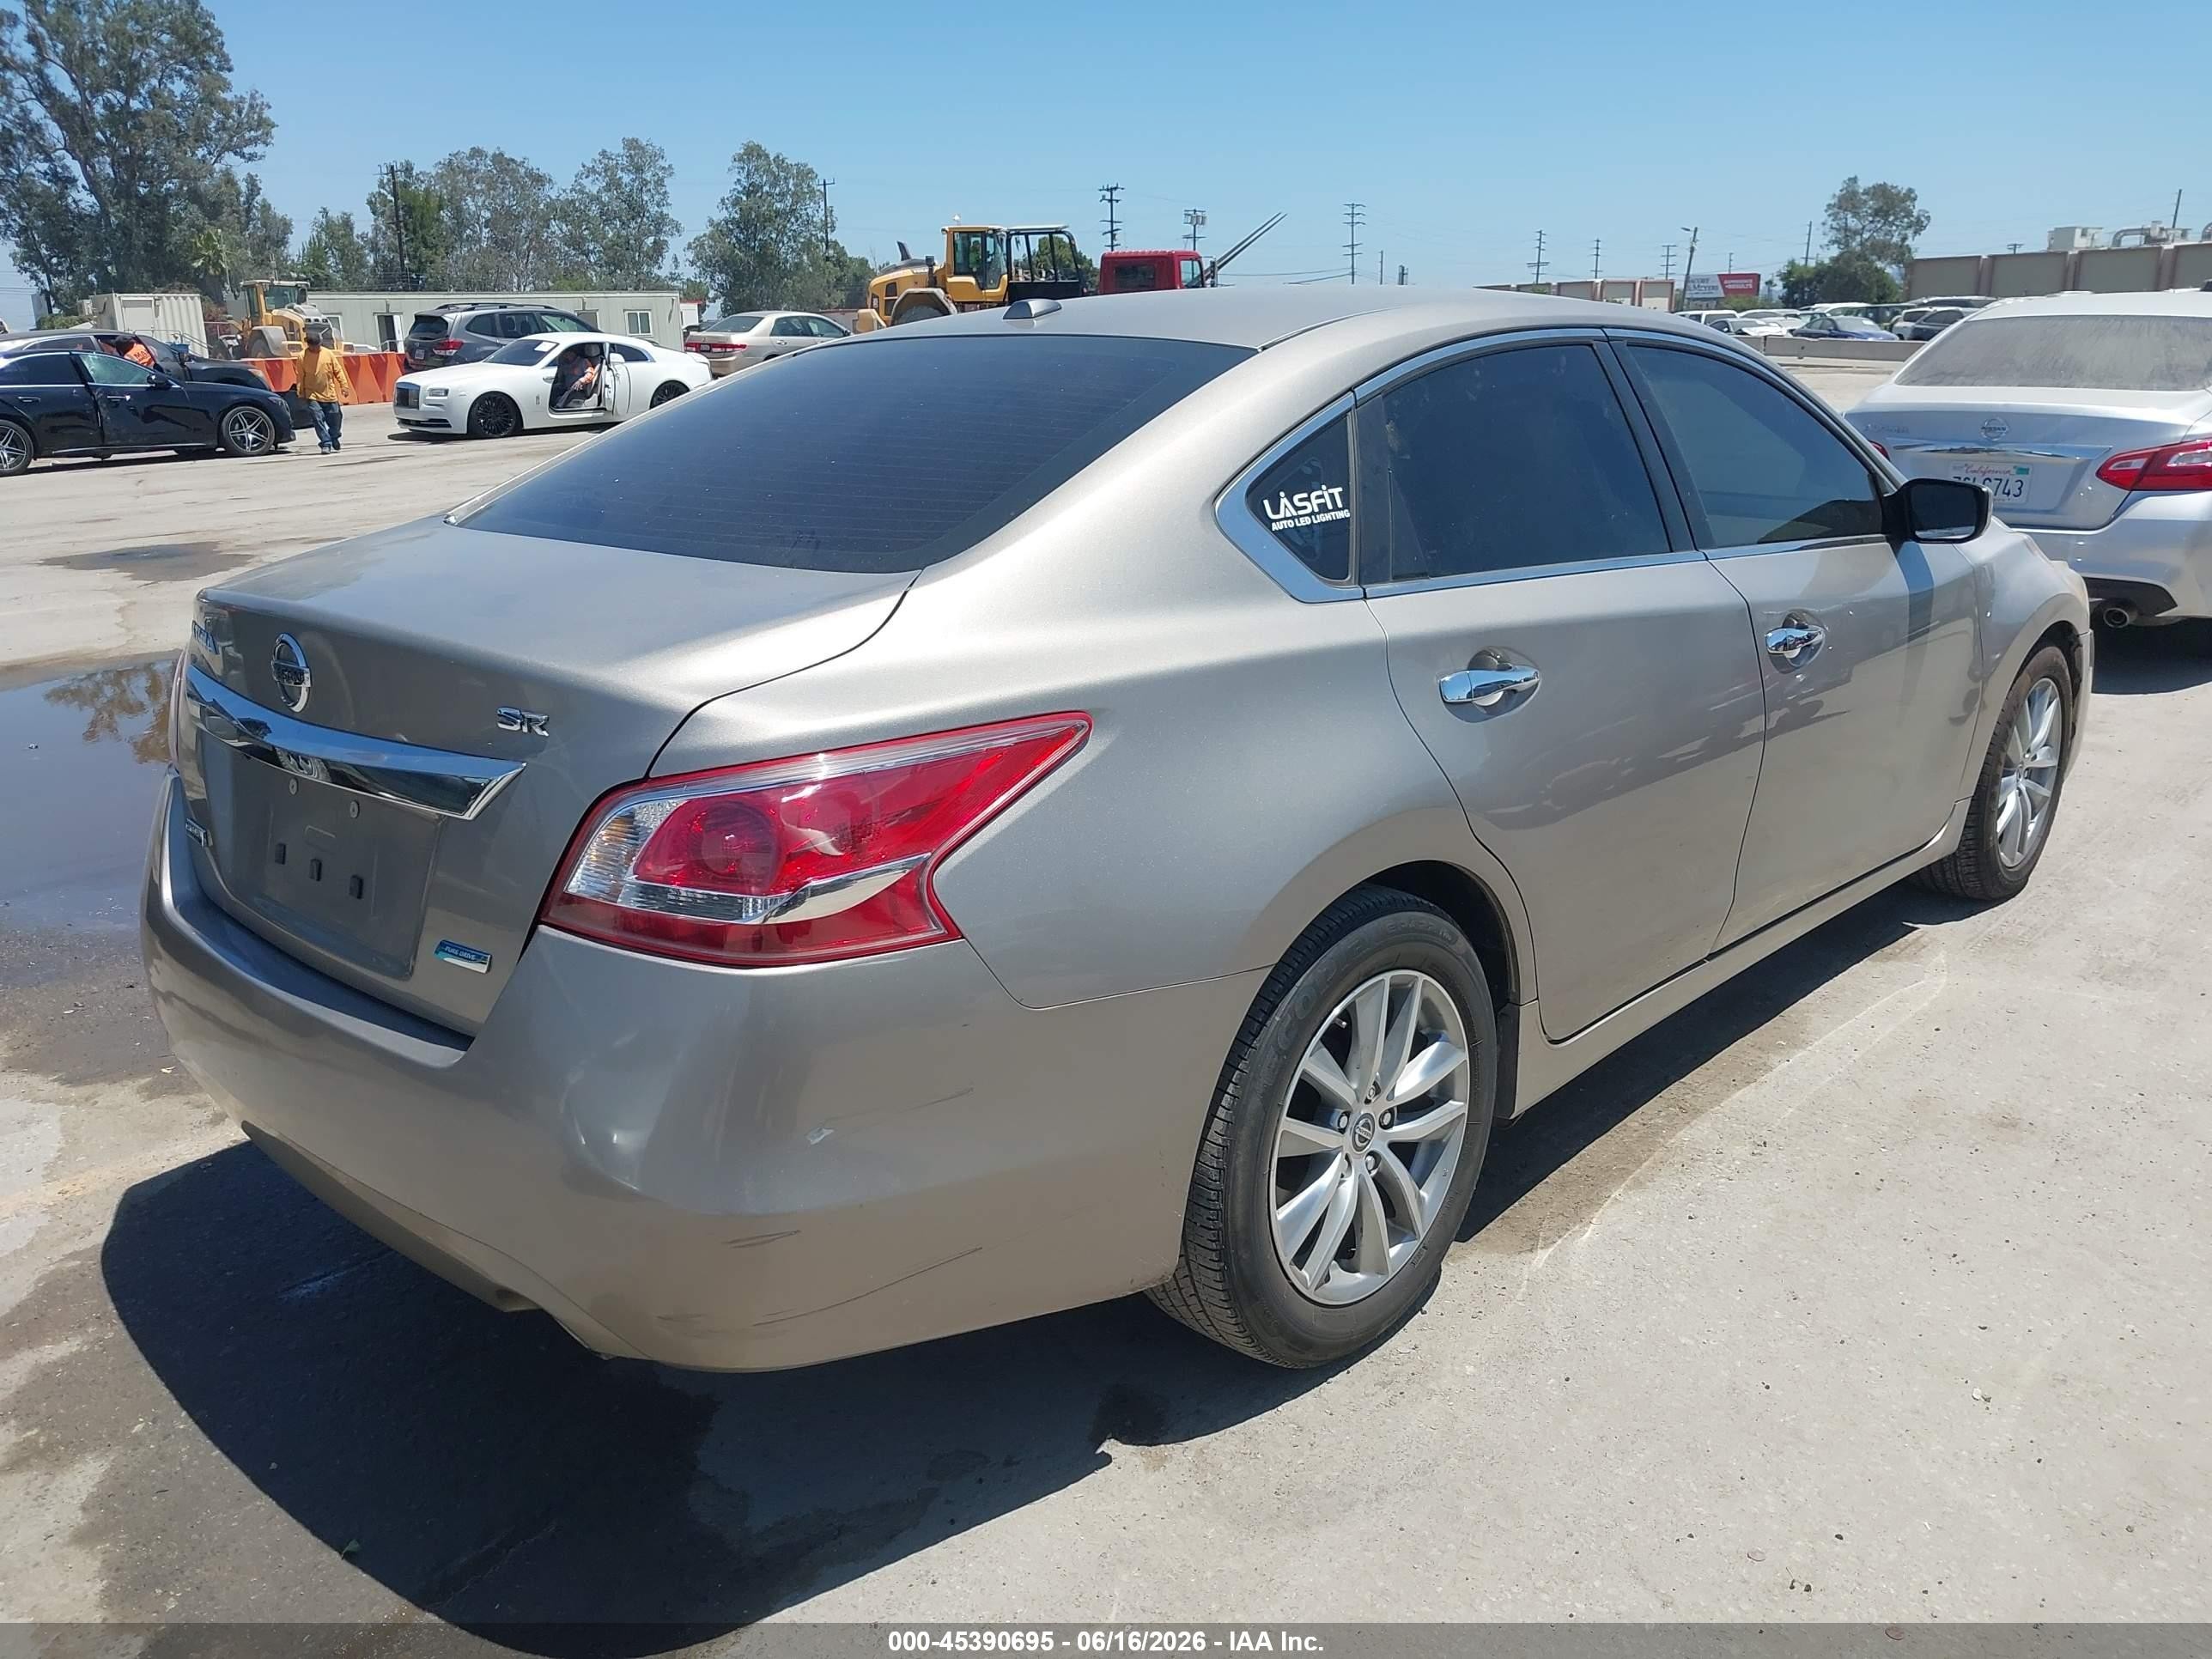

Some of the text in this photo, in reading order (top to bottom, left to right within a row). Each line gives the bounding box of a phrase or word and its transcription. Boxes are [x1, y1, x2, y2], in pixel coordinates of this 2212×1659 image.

[1965, 465, 2013, 477] California
[1271, 509, 1350, 532] AUTO LED LIGHTING
[496, 706, 550, 737] SR
[444, 945, 477, 961] PURE DRIVE
